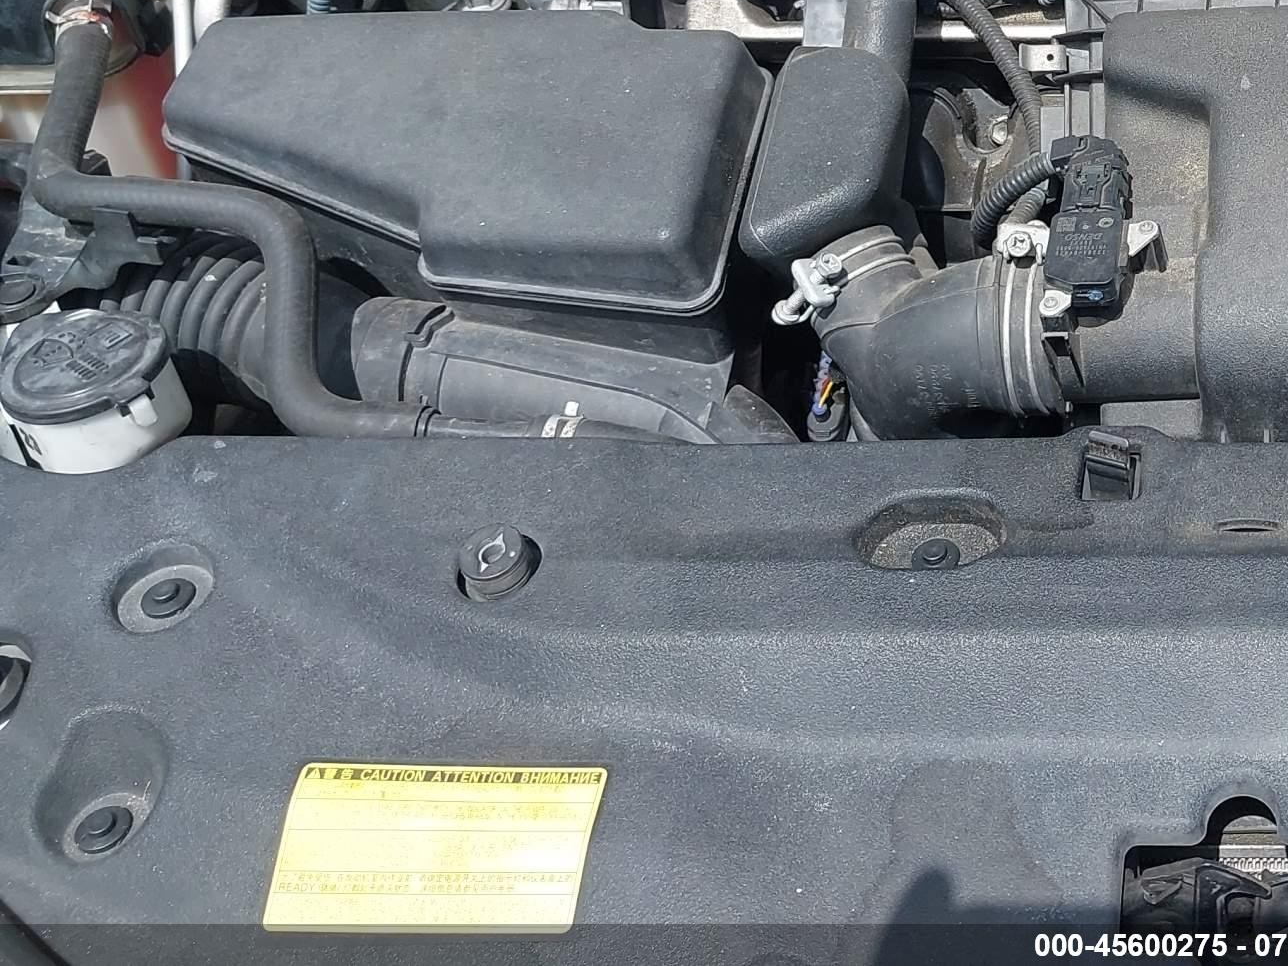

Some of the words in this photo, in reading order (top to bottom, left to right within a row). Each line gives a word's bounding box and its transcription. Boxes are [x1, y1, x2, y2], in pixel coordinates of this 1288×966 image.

[1064, 232, 1104, 241] DENSO
[360, 769, 426, 782] CAUTION
[431, 770, 517, 784] ATTENTION
[520, 771, 600, 784] ВНИМАНИЕ
